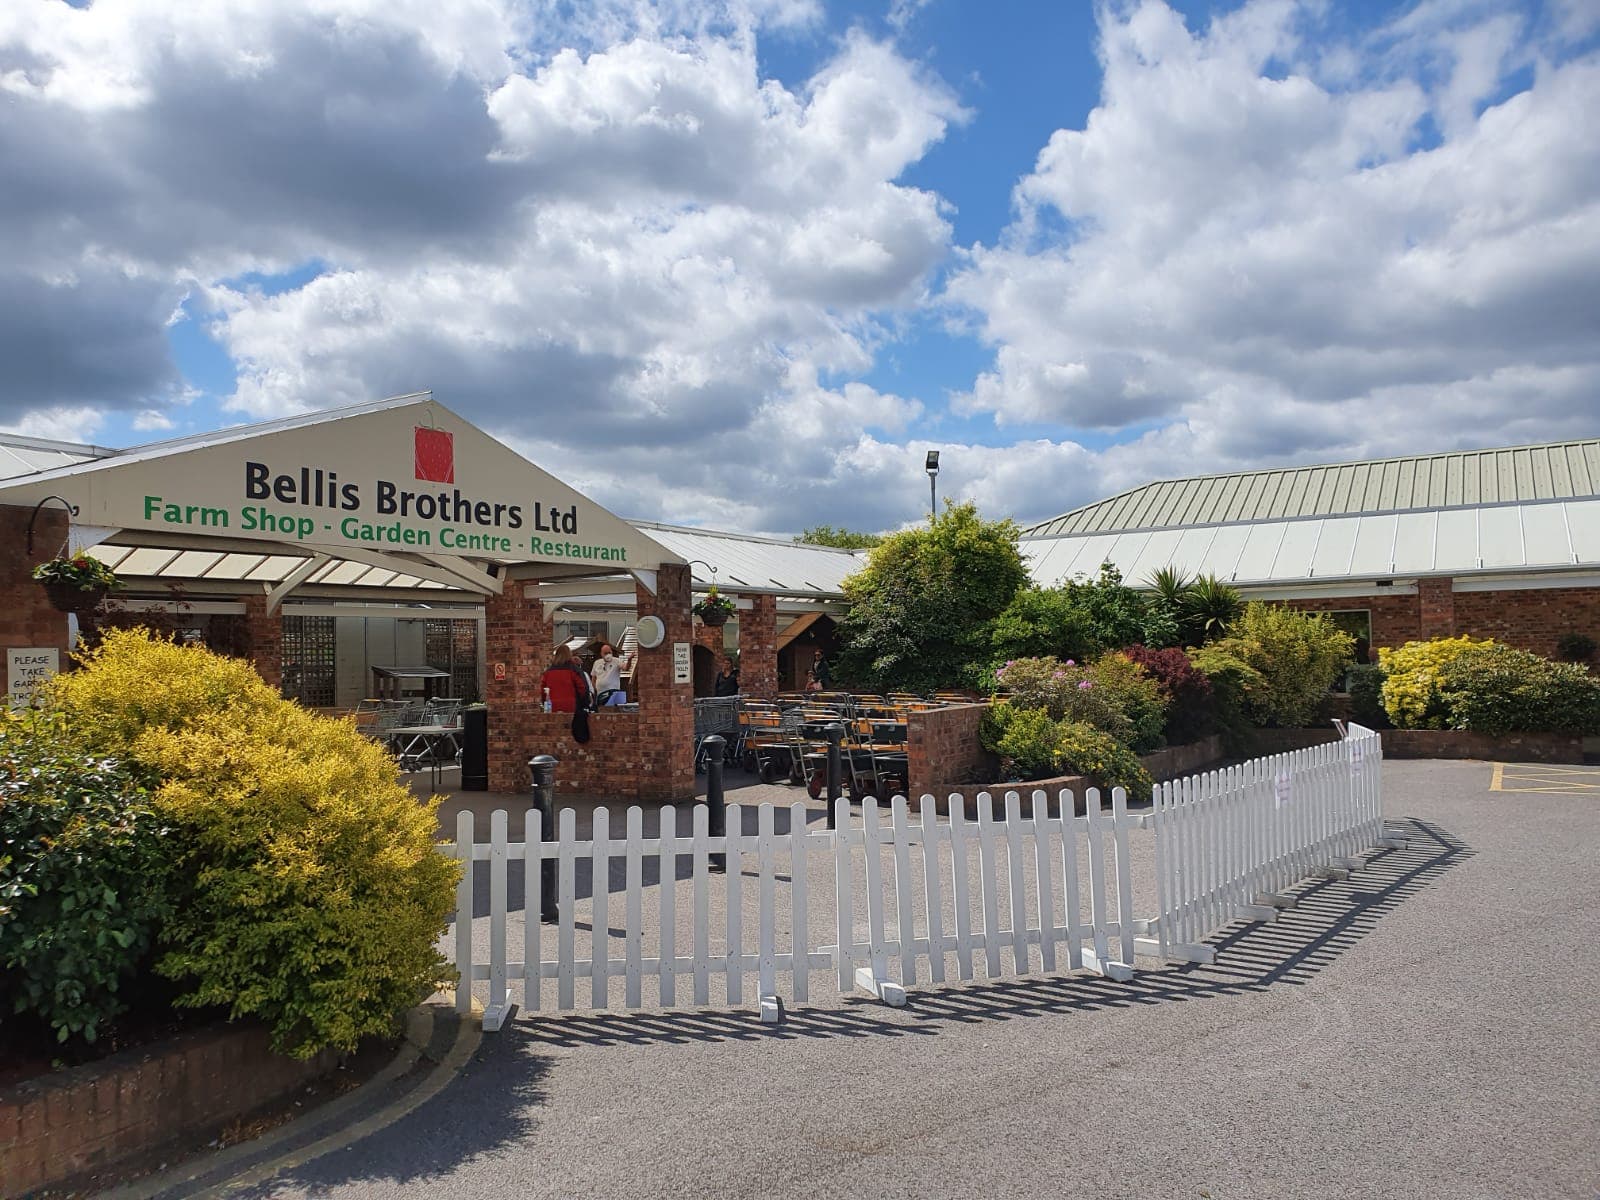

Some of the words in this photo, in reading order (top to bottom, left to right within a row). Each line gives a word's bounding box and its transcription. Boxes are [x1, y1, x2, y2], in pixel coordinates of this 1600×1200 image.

[246, 461, 361, 511] Bellis
[376, 480, 523, 529] Brothers
[534, 502, 578, 535] Ltd
[143, 496, 229, 528] Farm
[241, 507, 315, 539] Shop
[340, 518, 431, 545] Garden
[438, 528, 511, 552] Centre
[530, 537, 628, 562] Restaurant
[14, 655, 50, 665] PLEASE
[19, 667, 45, 676] TAKE
